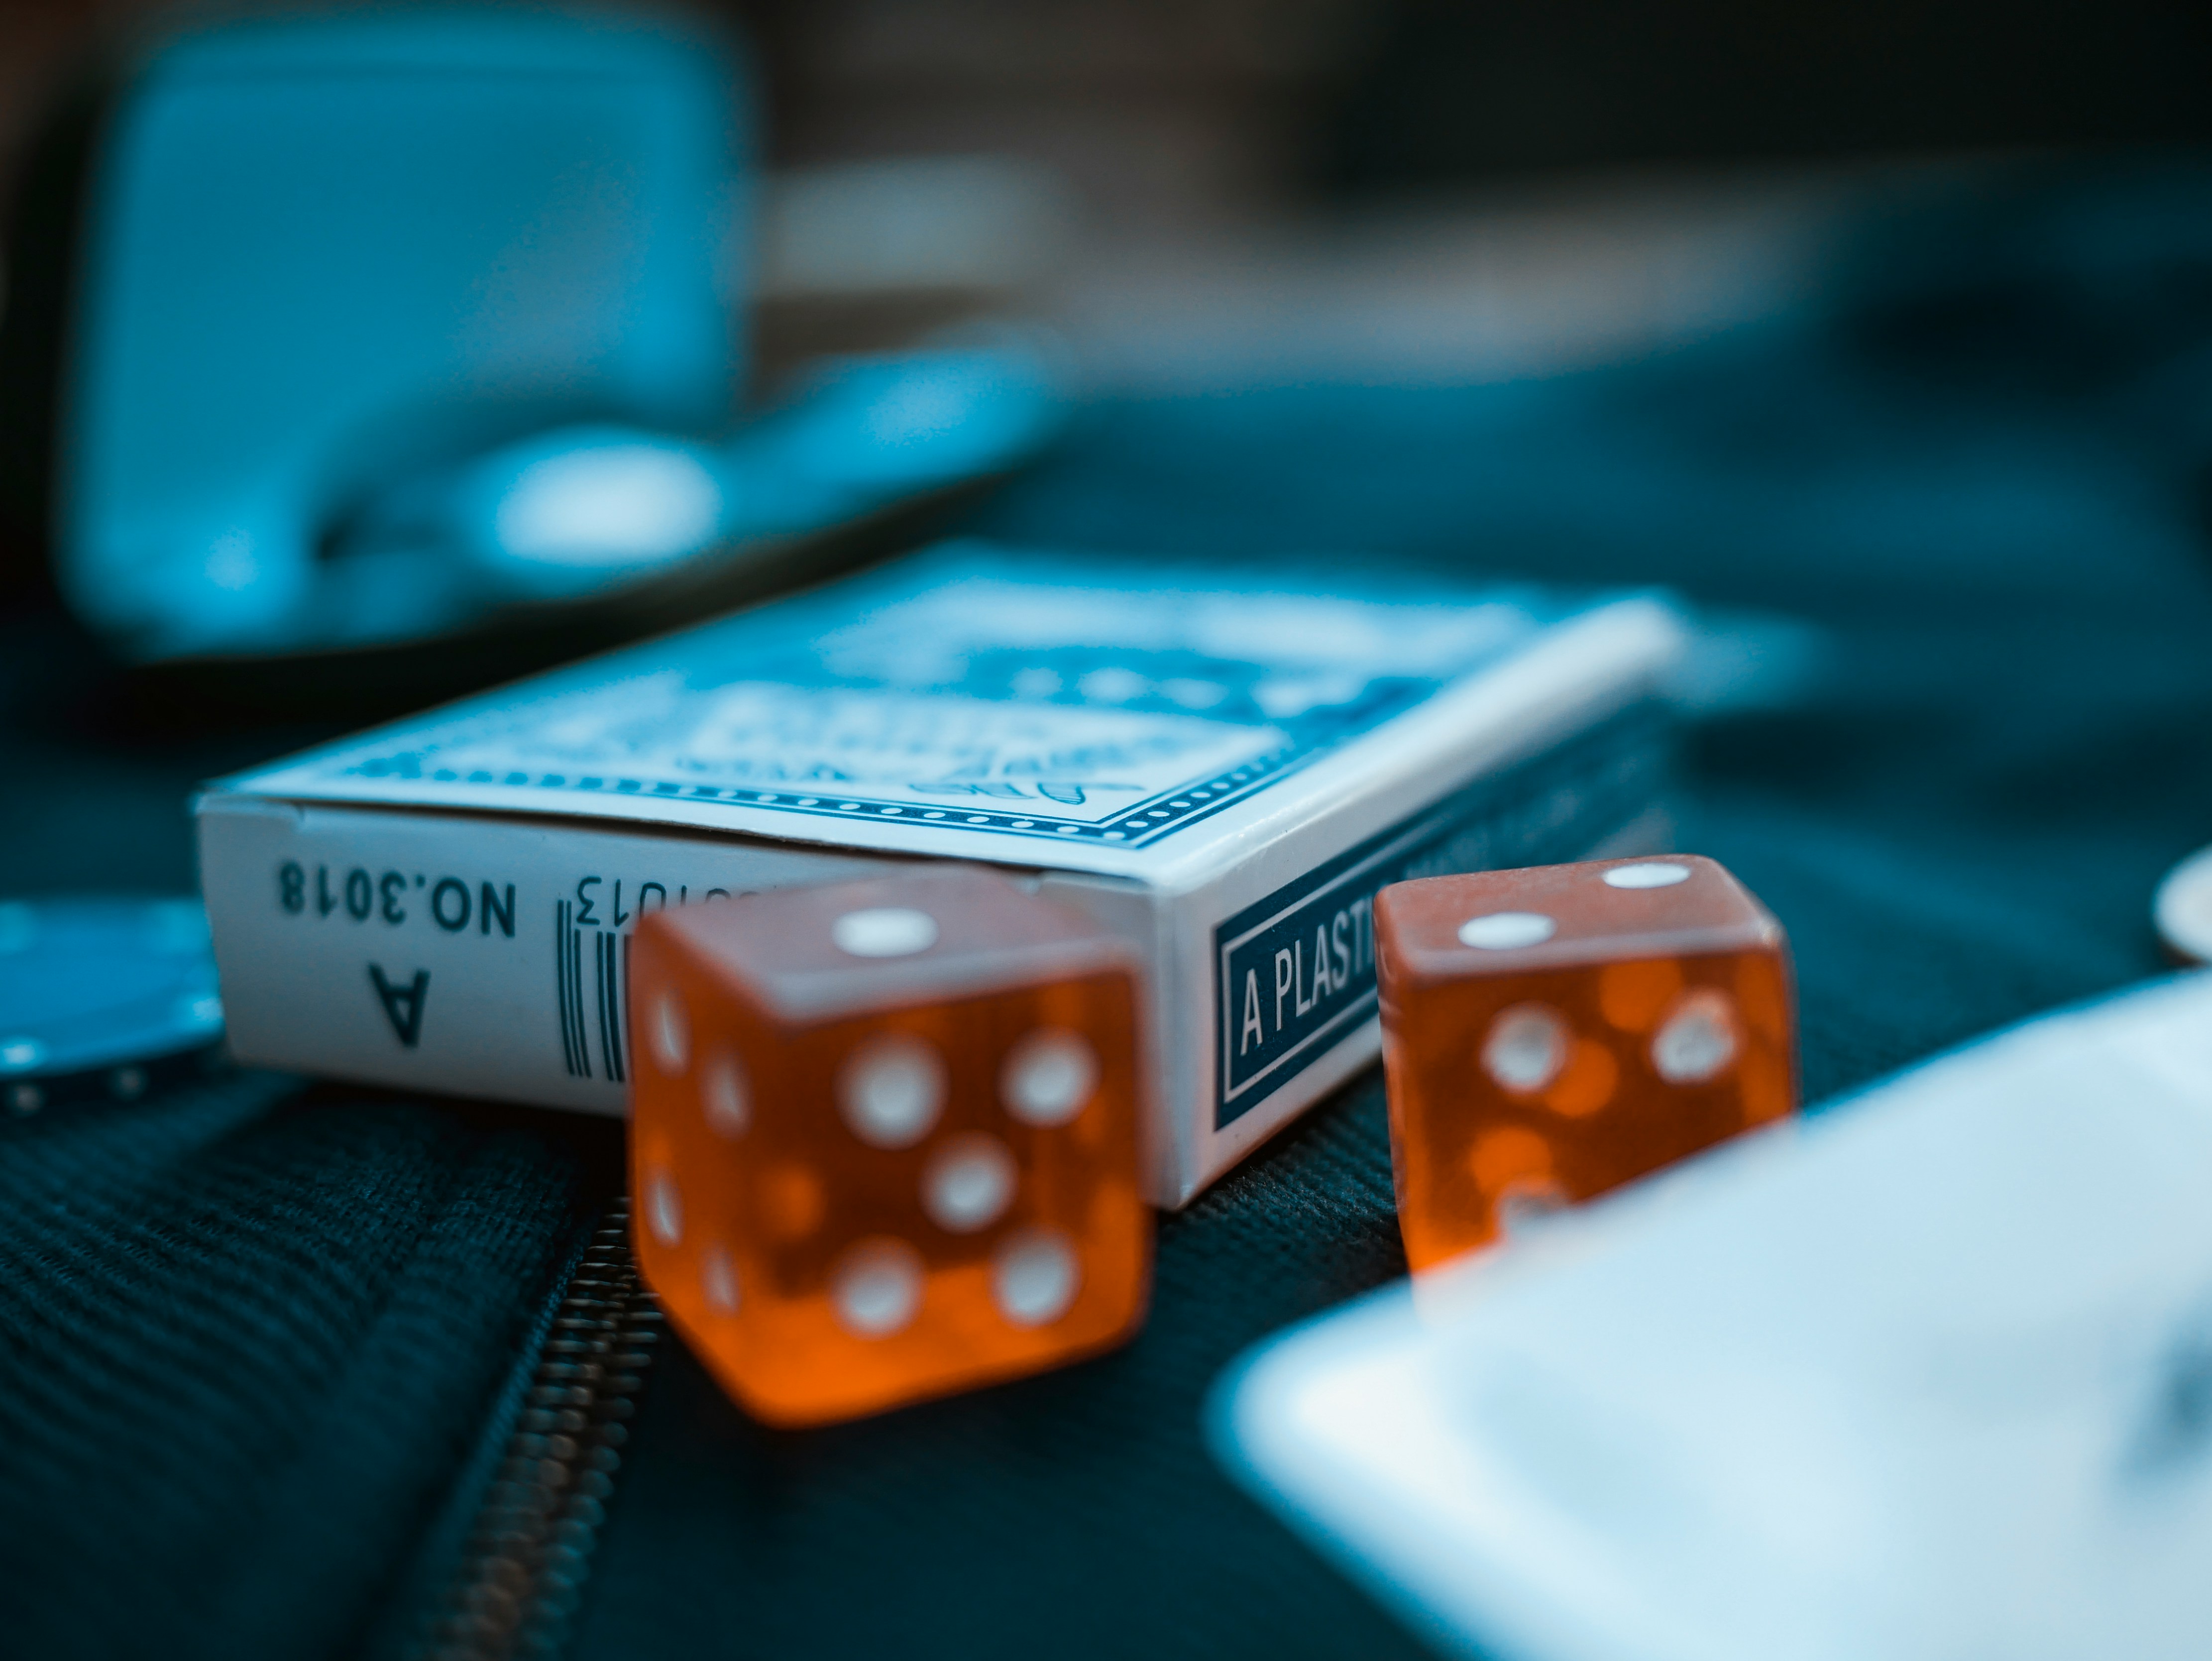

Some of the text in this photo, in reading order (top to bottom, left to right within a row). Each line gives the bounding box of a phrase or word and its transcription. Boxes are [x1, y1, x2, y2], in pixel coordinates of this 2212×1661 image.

[279, 861, 516, 938] NO.3018
[368, 963, 430, 1047] A
[1240, 968, 1263, 1056] A
